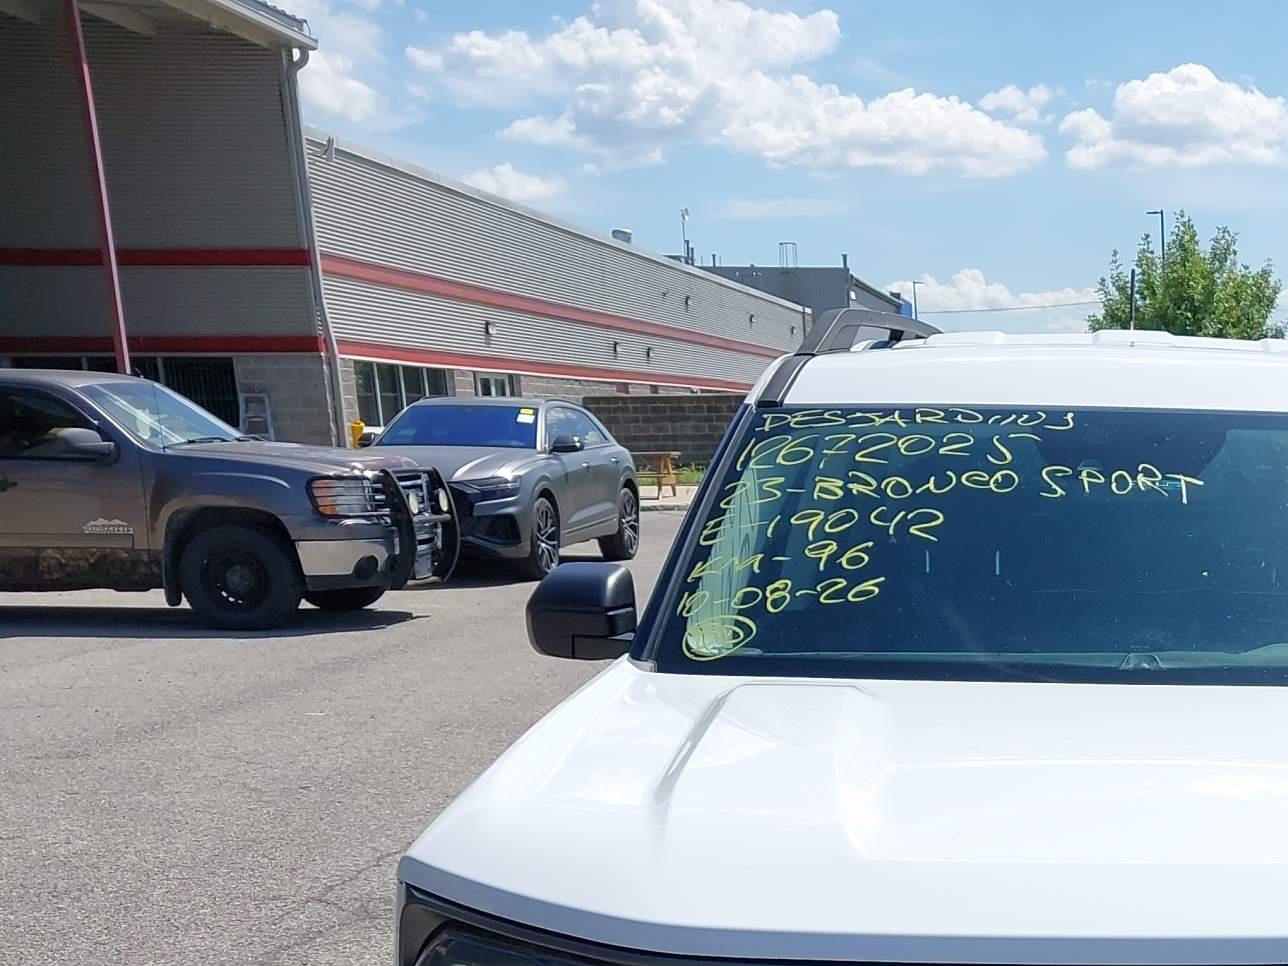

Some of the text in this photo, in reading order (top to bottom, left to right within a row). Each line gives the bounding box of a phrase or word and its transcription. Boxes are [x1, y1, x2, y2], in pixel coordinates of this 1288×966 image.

[736, 433, 1042, 471] 12672025
[719, 463, 1204, 508] 23-BRONCO SPORT
[687, 540, 875, 582] KM-96
